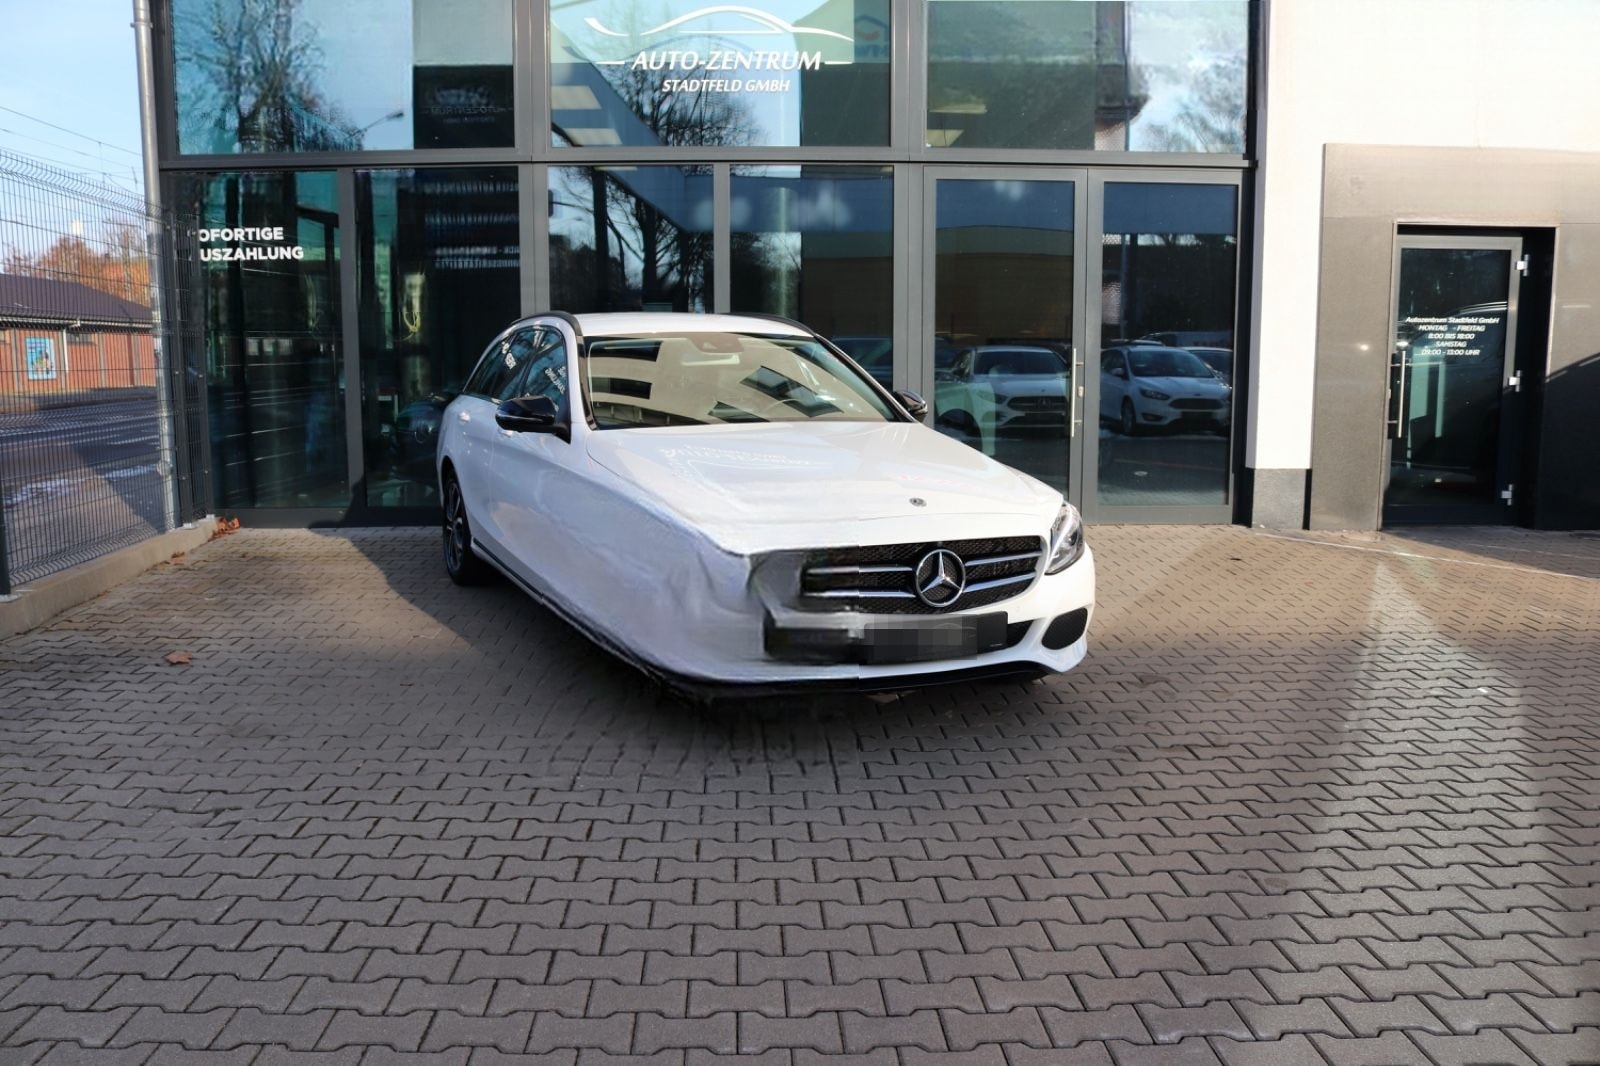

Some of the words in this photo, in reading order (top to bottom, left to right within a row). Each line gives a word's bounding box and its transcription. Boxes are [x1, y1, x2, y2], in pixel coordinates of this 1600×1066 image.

[632, 50, 822, 71] AUTO-ZENTRUM
[662, 79, 742, 92] STADTFELD
[745, 79, 790, 93] GMBH
[189, 246, 304, 262] USZAHLUNG
[1405, 316, 1448, 324] Autozentrum
[1448, 316, 1478, 324] Stadtfeld
